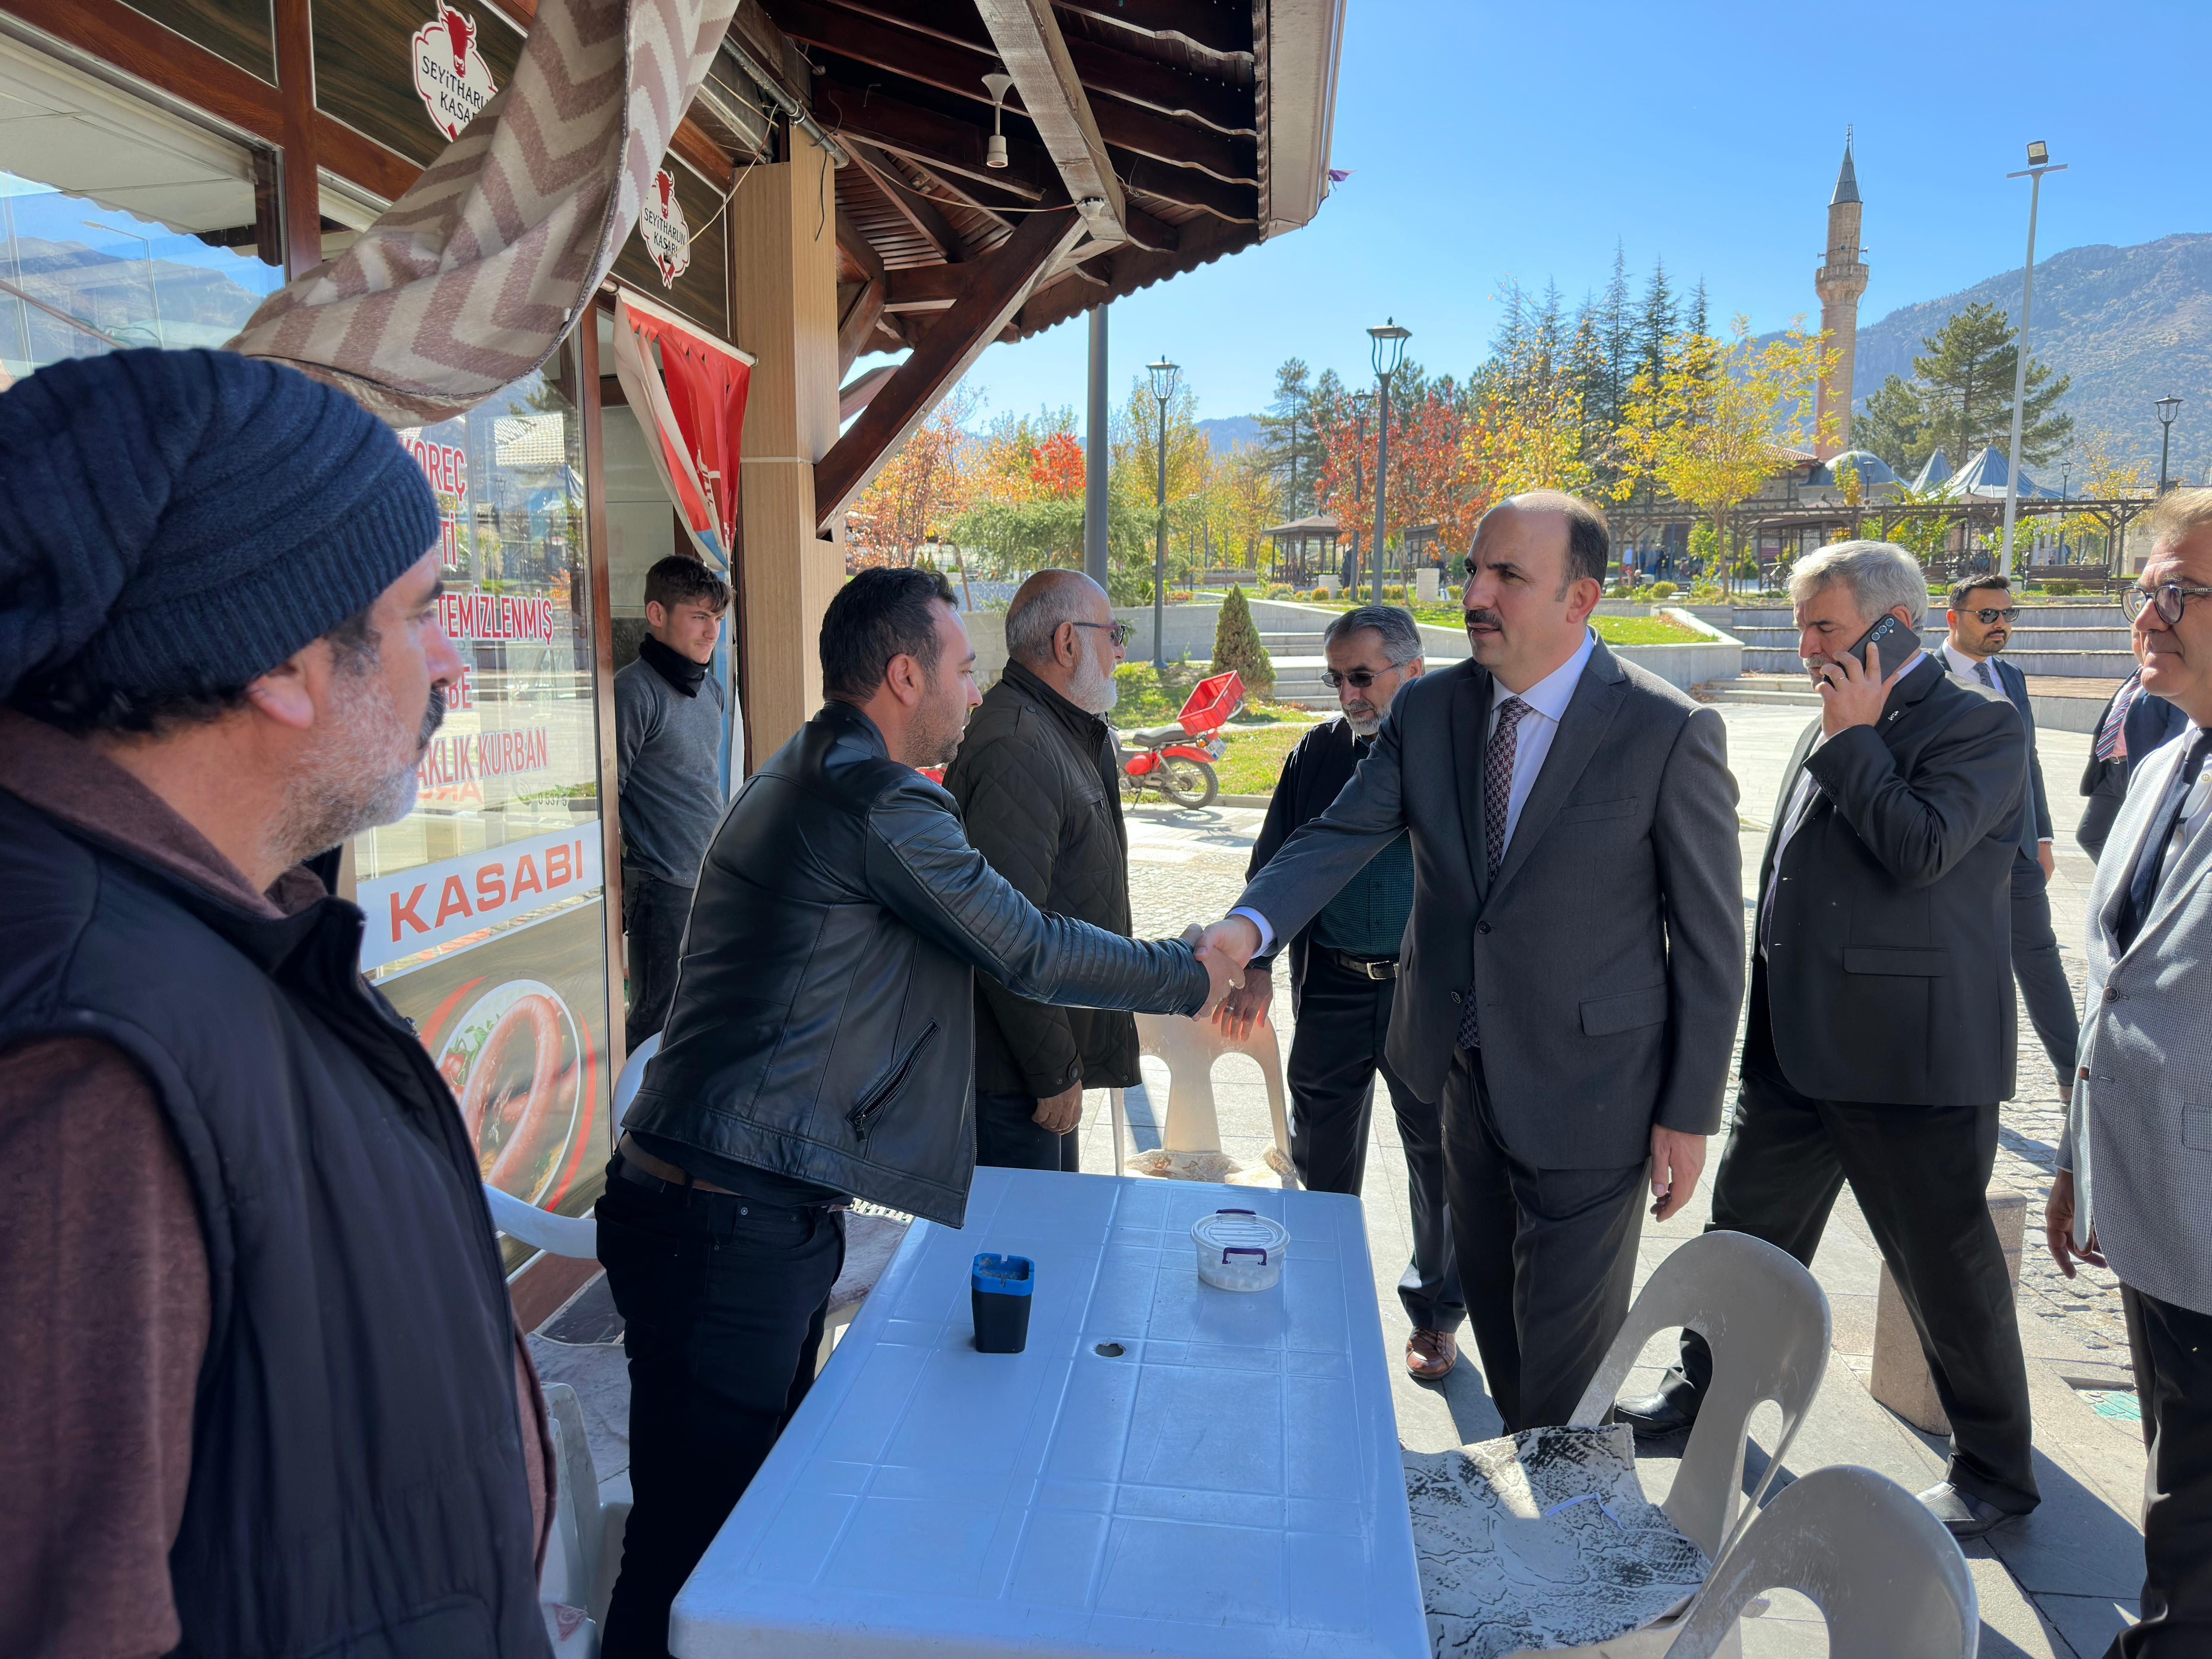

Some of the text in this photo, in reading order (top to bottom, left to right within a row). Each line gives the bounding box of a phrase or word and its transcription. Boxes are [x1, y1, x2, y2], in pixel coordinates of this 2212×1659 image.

[440, 91, 477, 123] KASA
[438, 587, 552, 645] TEMİZLENMİŞ
[478, 729, 547, 777] KURBAN
[390, 840, 583, 942] KASABI
